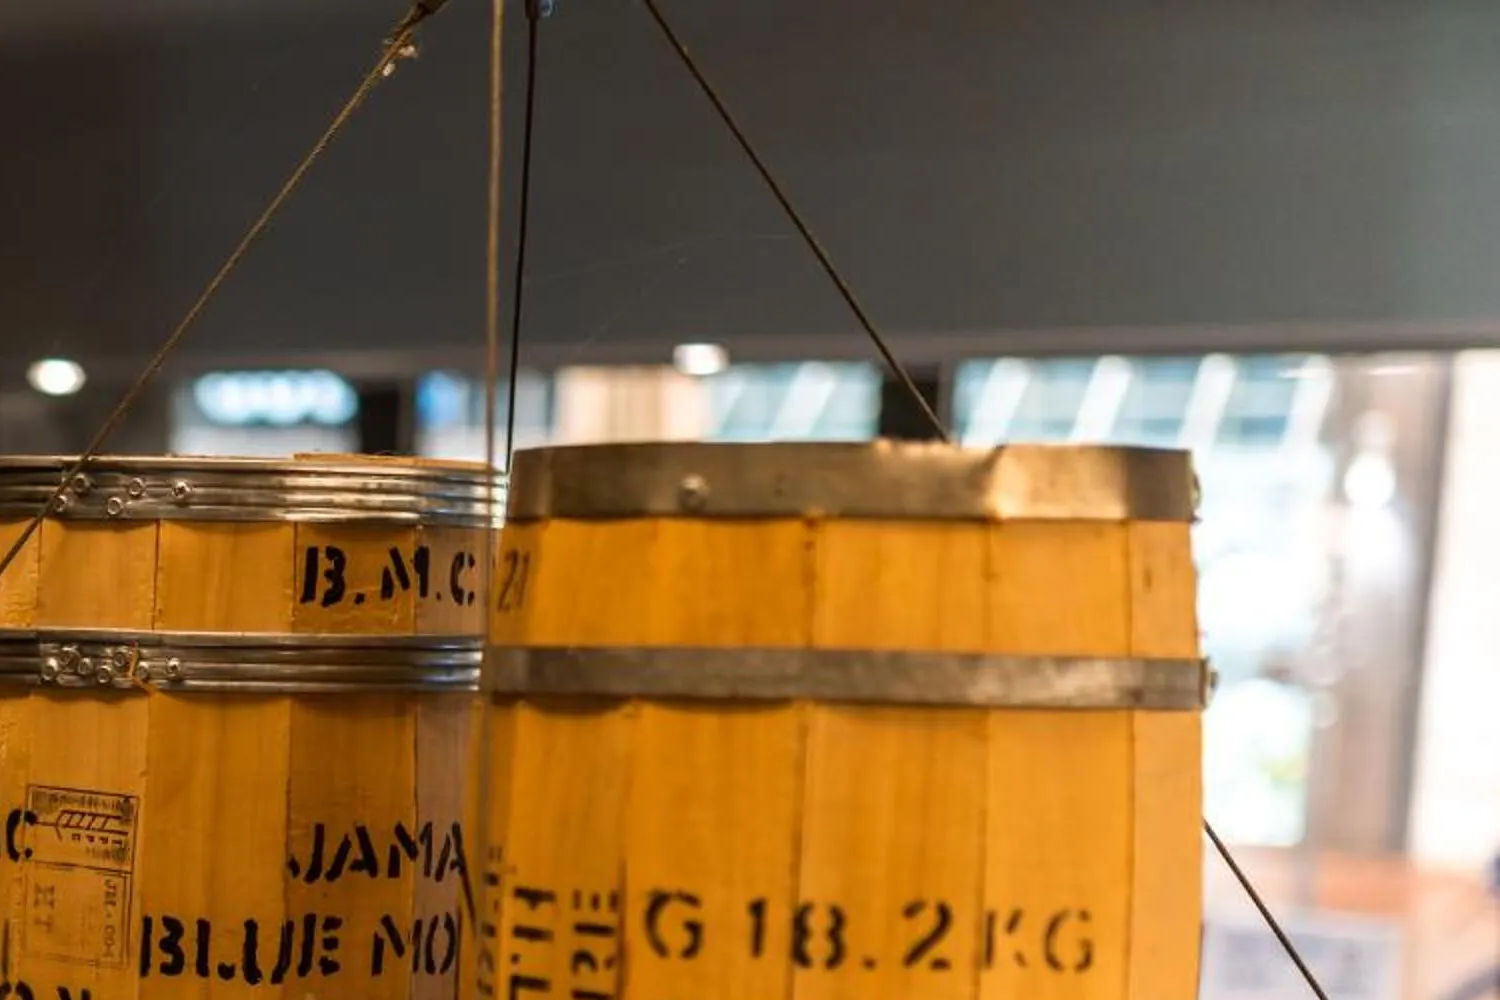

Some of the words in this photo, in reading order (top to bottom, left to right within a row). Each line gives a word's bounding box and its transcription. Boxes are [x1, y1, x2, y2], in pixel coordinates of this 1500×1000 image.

[286, 820, 466, 884] JAMA
[139, 913, 342, 986] BLUE
[371, 912, 456, 977] MO
[644, 889, 703, 960] G
[747, 898, 953, 971] 18.2
[984, 909, 1094, 973] KG
